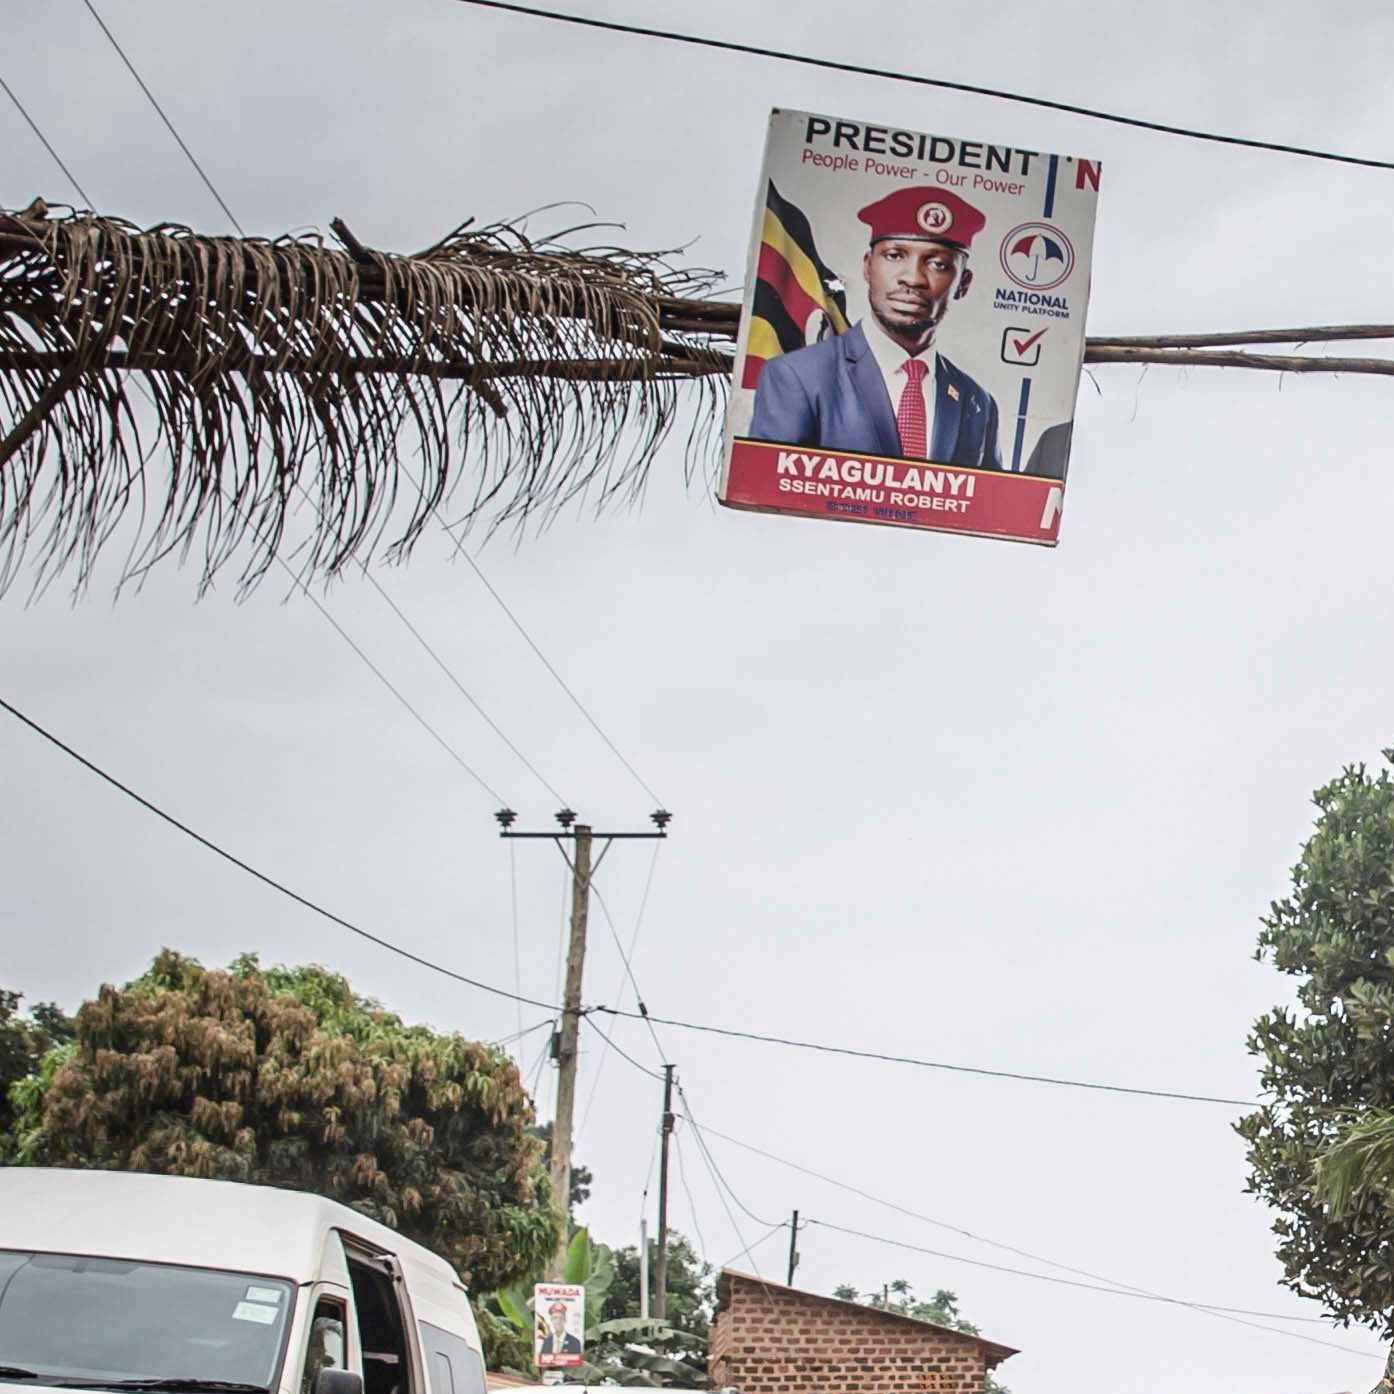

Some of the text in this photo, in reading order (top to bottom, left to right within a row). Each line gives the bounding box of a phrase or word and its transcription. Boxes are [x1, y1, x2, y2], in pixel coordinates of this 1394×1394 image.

[805, 116, 1039, 176] PRESIDENT
[802, 149, 859, 172] People
[865, 159, 918, 179] Power
[935, 169, 967, 187] Our
[973, 174, 1026, 196] Power
[993, 302, 1070, 319] UNITY PLATFORM
[995, 288, 1069, 310] NATIONAL
[777, 452, 976, 497] KYAGULANYI
[779, 478, 971, 513] SSENTAMU ROBERT
